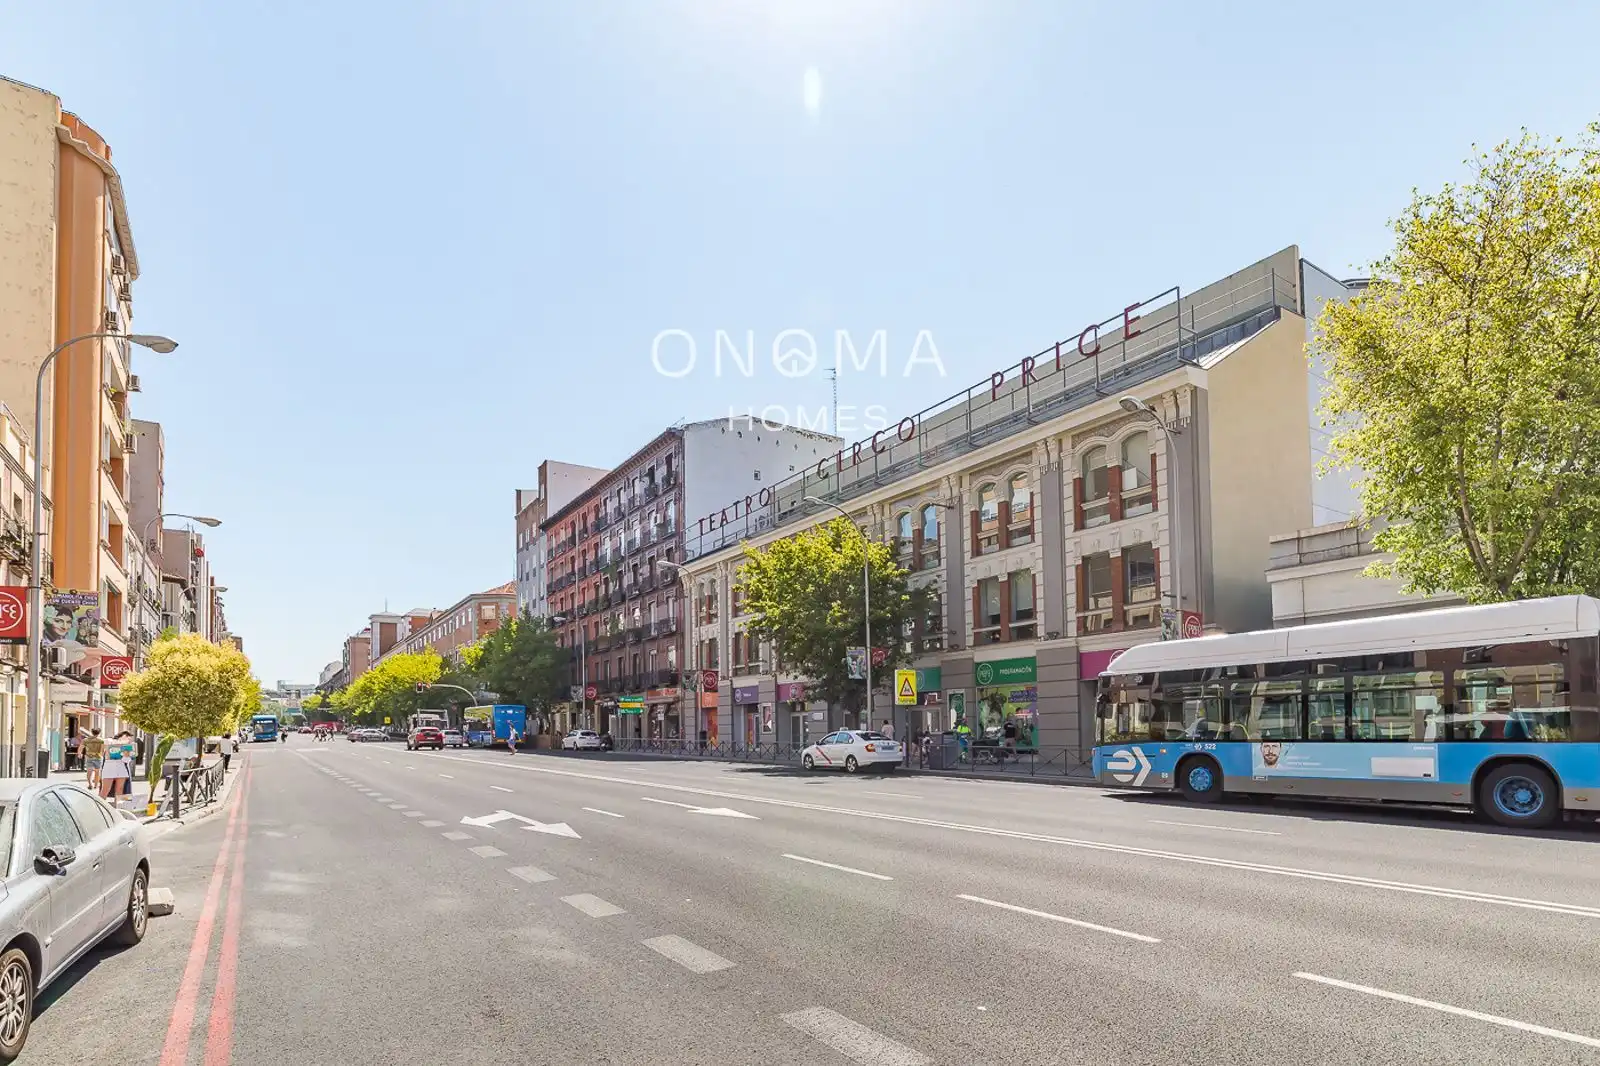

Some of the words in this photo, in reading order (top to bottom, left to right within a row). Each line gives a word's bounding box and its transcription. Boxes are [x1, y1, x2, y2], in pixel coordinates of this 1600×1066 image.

[699, 487, 771, 536] TEATRO
[817, 416, 915, 480] CIRCO
[991, 302, 1142, 401] PRICE
